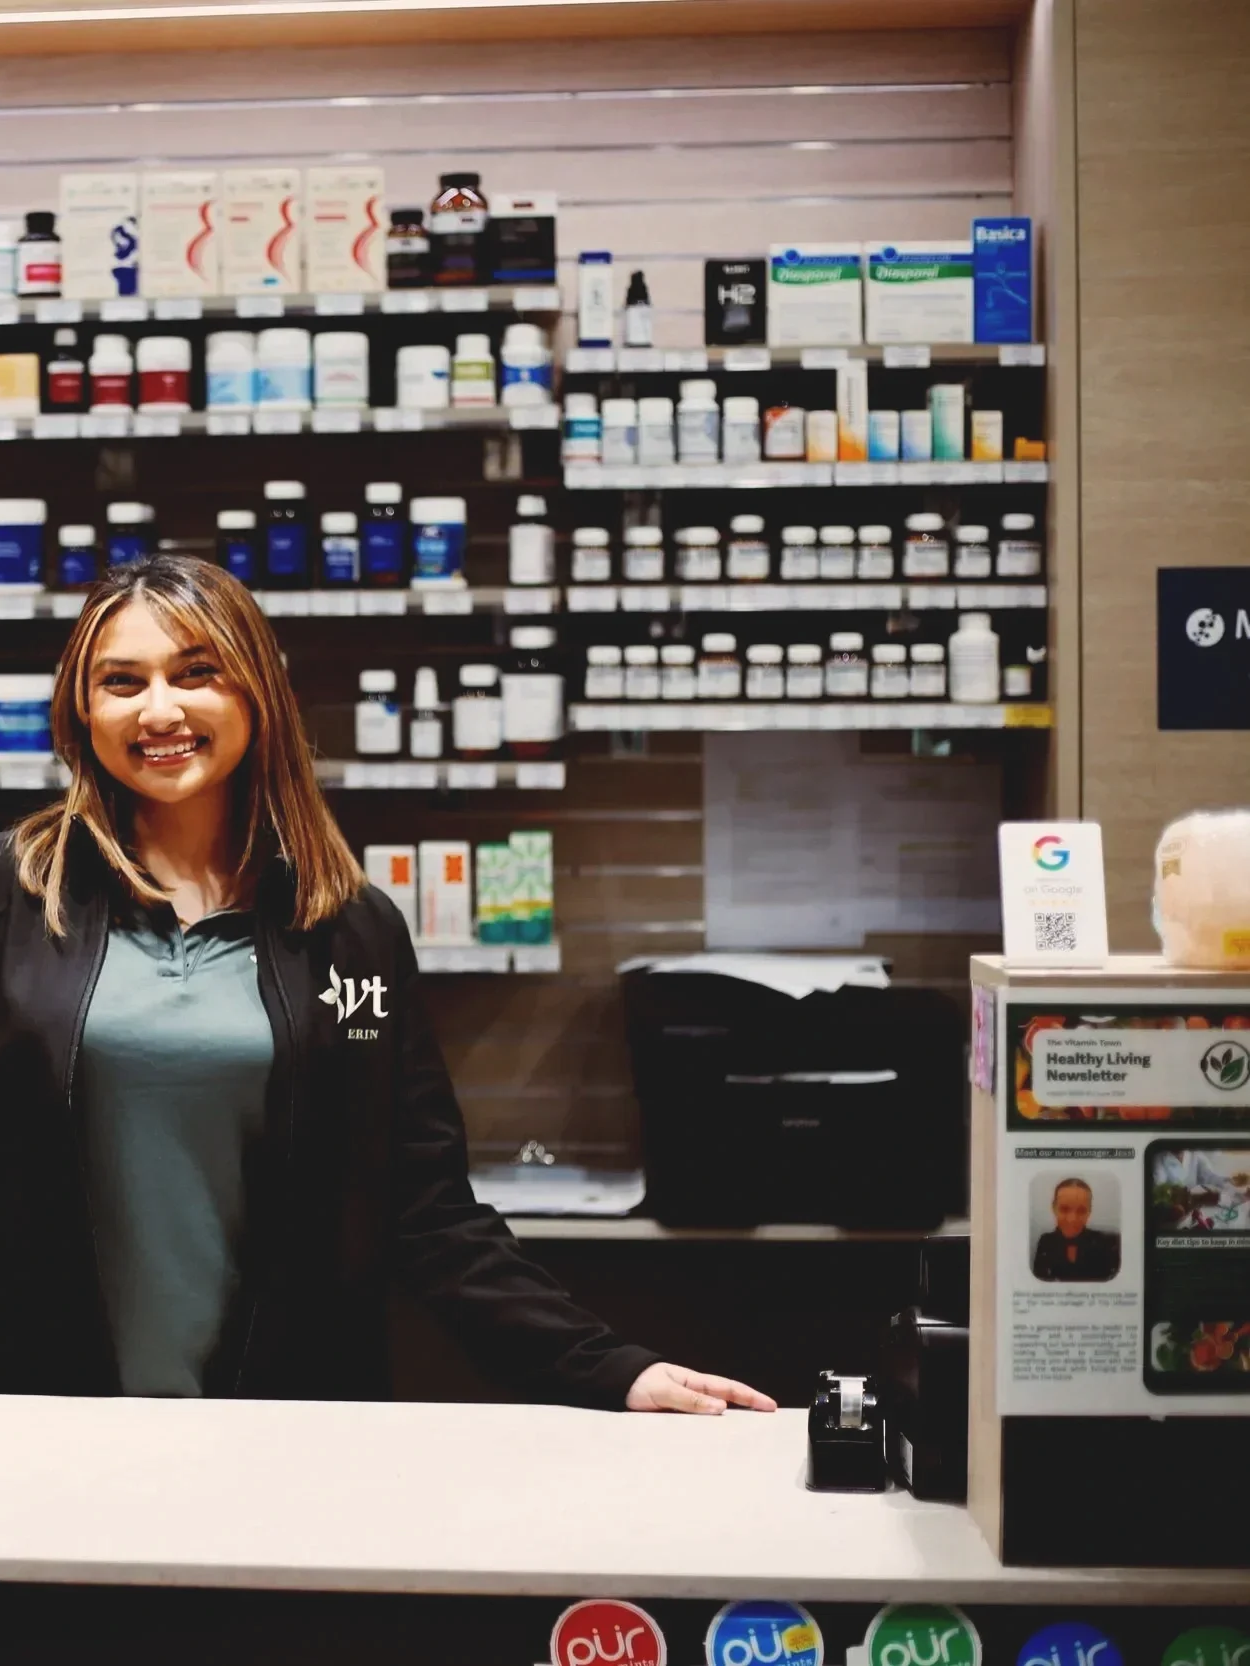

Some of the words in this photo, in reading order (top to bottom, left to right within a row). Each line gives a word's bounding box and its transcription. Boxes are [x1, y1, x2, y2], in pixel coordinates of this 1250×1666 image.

[976, 226, 1026, 241] Basica
[347, 1028, 378, 1040] ERIN
[1047, 1039, 1062, 1047] The
[1065, 1039, 1098, 1047] Vitamin
[1100, 1039, 1122, 1047] Town
[1046, 1052, 1103, 1068] Healthy
[1107, 1052, 1151, 1068] Living
[1046, 1069, 1128, 1082] Newsletter
[1015, 1148, 1037, 1158] Meet
[1055, 1149, 1073, 1158] new
